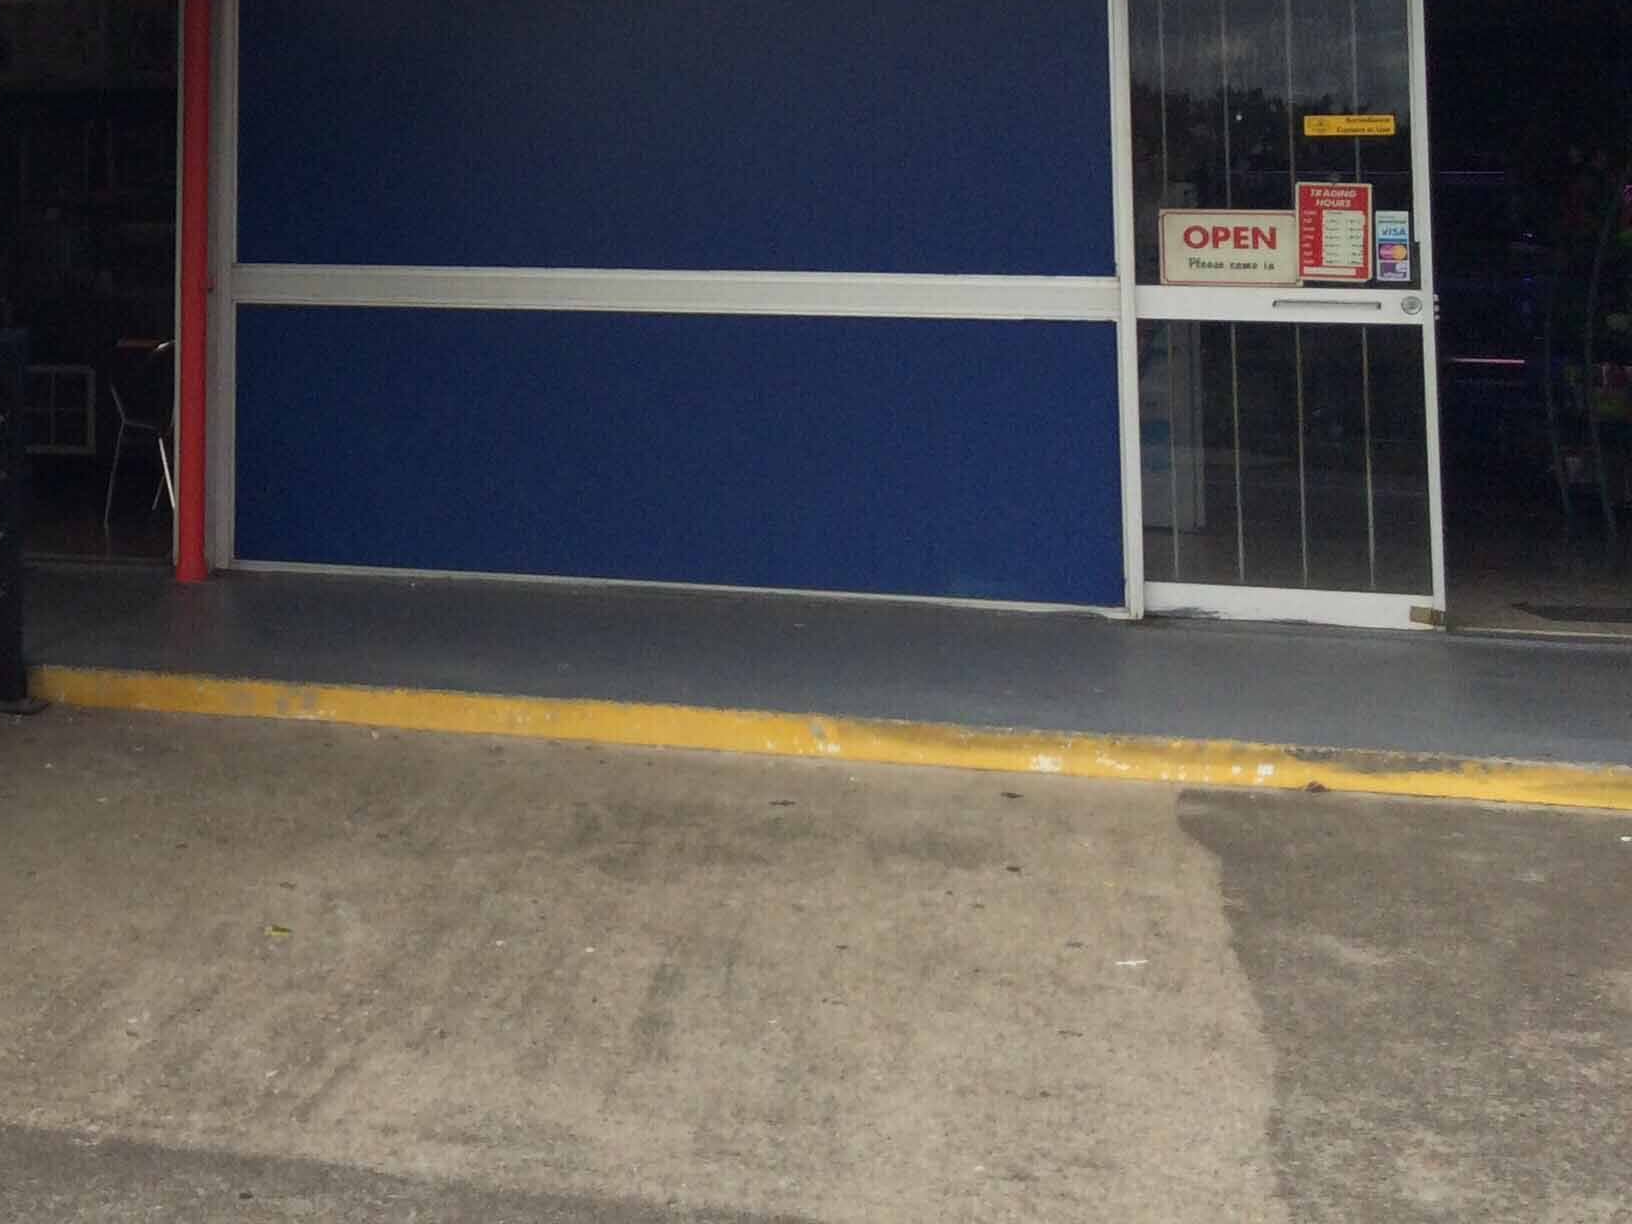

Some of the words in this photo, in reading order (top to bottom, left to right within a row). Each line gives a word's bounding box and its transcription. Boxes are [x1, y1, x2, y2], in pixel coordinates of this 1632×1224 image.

[1311, 188, 1357, 198] TRADING
[1315, 199, 1351, 208] HOURS
[1183, 225, 1277, 249] OPEN
